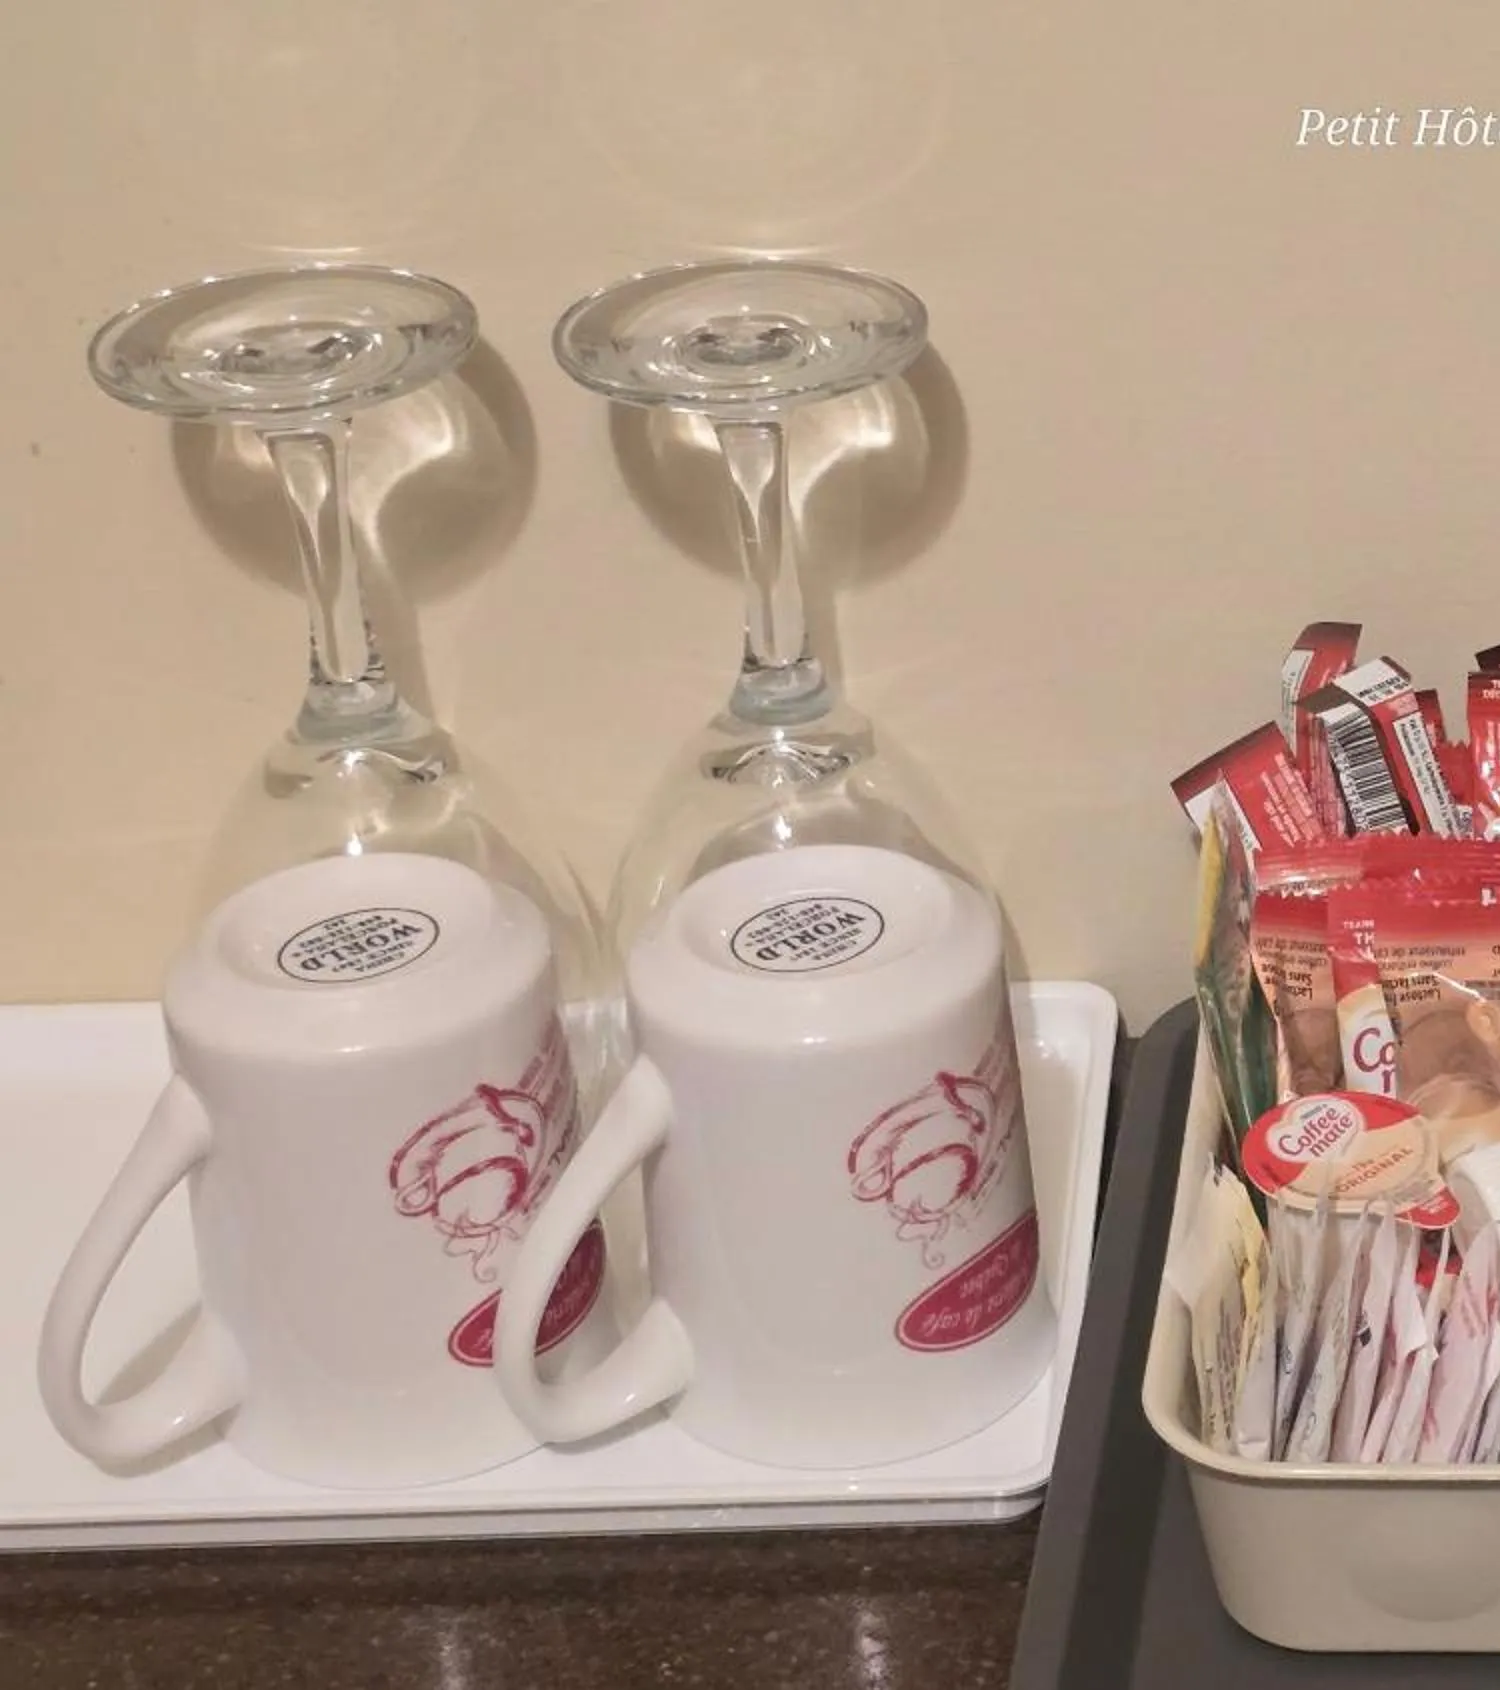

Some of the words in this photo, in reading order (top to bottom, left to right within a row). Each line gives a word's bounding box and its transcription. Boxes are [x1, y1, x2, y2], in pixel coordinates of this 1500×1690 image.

[301, 924, 423, 971] WORLD
[756, 912, 866, 961] WORLD
[1354, 931, 1375, 945] TH
[1278, 1106, 1341, 1157] Coffee
[1308, 1113, 1354, 1157] mate
